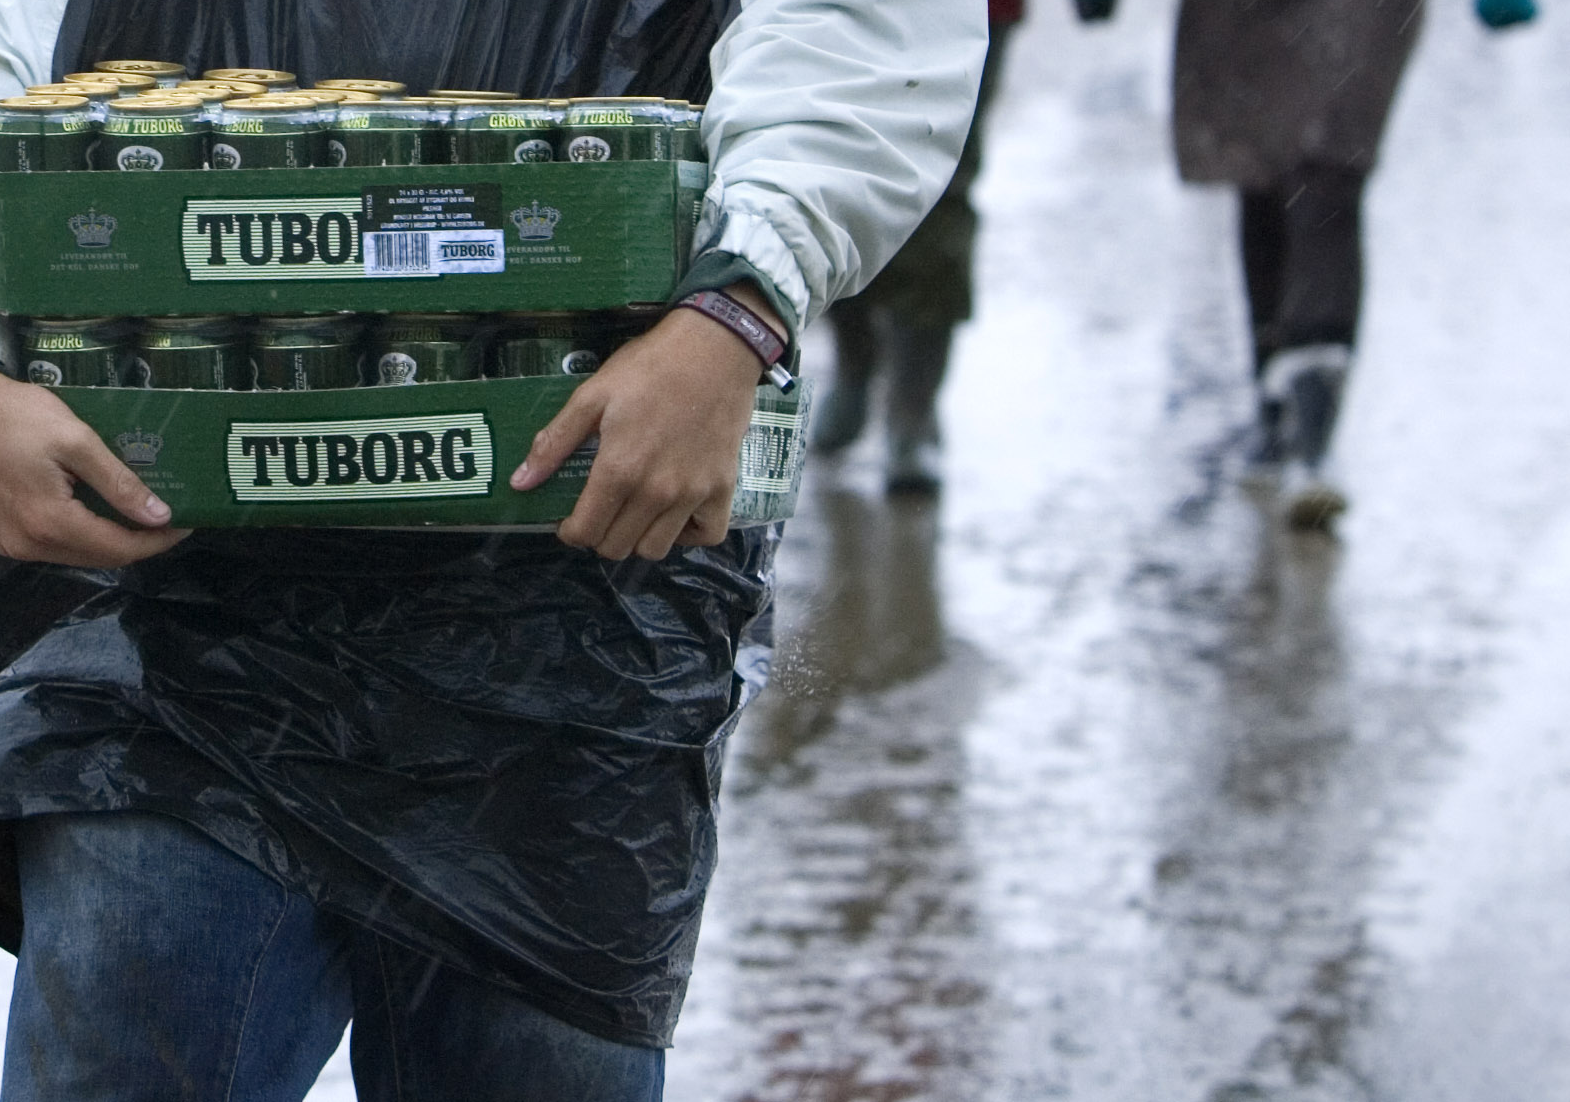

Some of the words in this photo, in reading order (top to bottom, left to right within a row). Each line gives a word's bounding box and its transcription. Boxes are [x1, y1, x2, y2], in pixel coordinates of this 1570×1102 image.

[489, 114, 526, 128] GRØN
[583, 109, 633, 124] TUBORG
[133, 118, 184, 133] TUBORG
[439, 244, 495, 258] TUBORG
[37, 333, 83, 348] TUBORG
[241, 428, 477, 487] TUBORG
